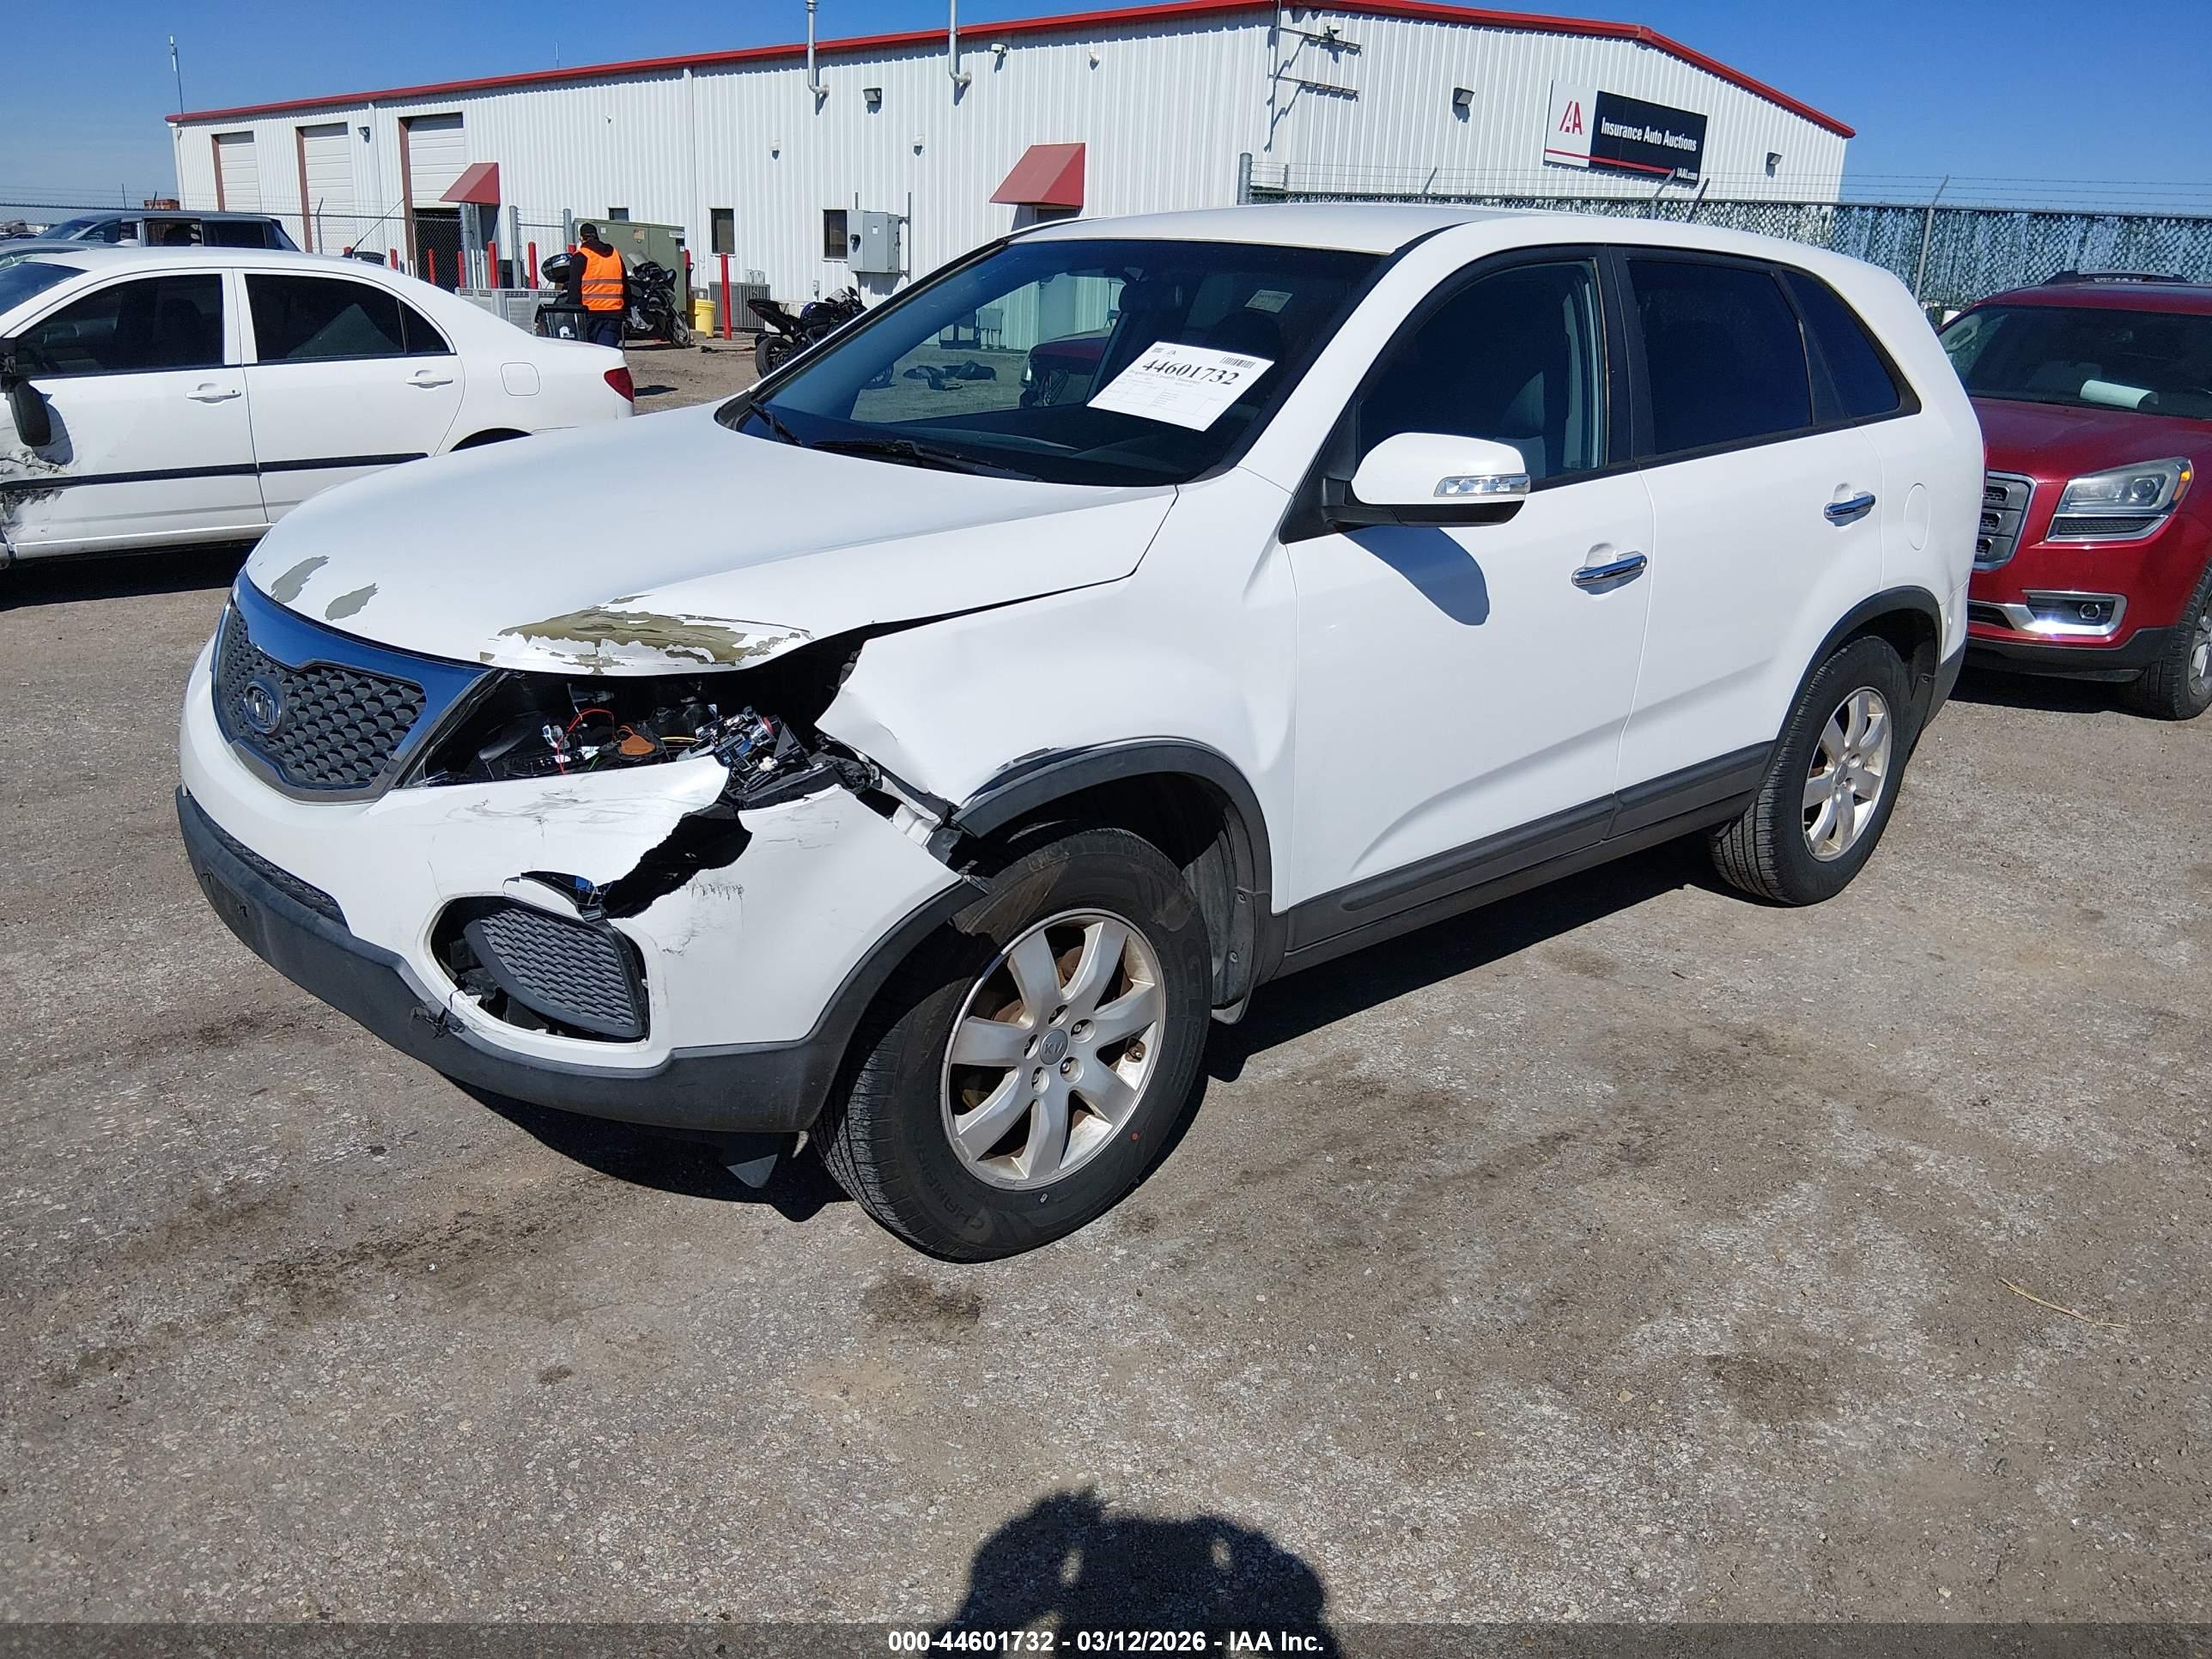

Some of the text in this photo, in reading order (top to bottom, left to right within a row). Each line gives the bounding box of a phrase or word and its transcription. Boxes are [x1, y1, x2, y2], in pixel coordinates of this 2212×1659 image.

[1601, 117, 1697, 152] Insurance Auto Auctions
[1142, 359, 1240, 386] 44601732
